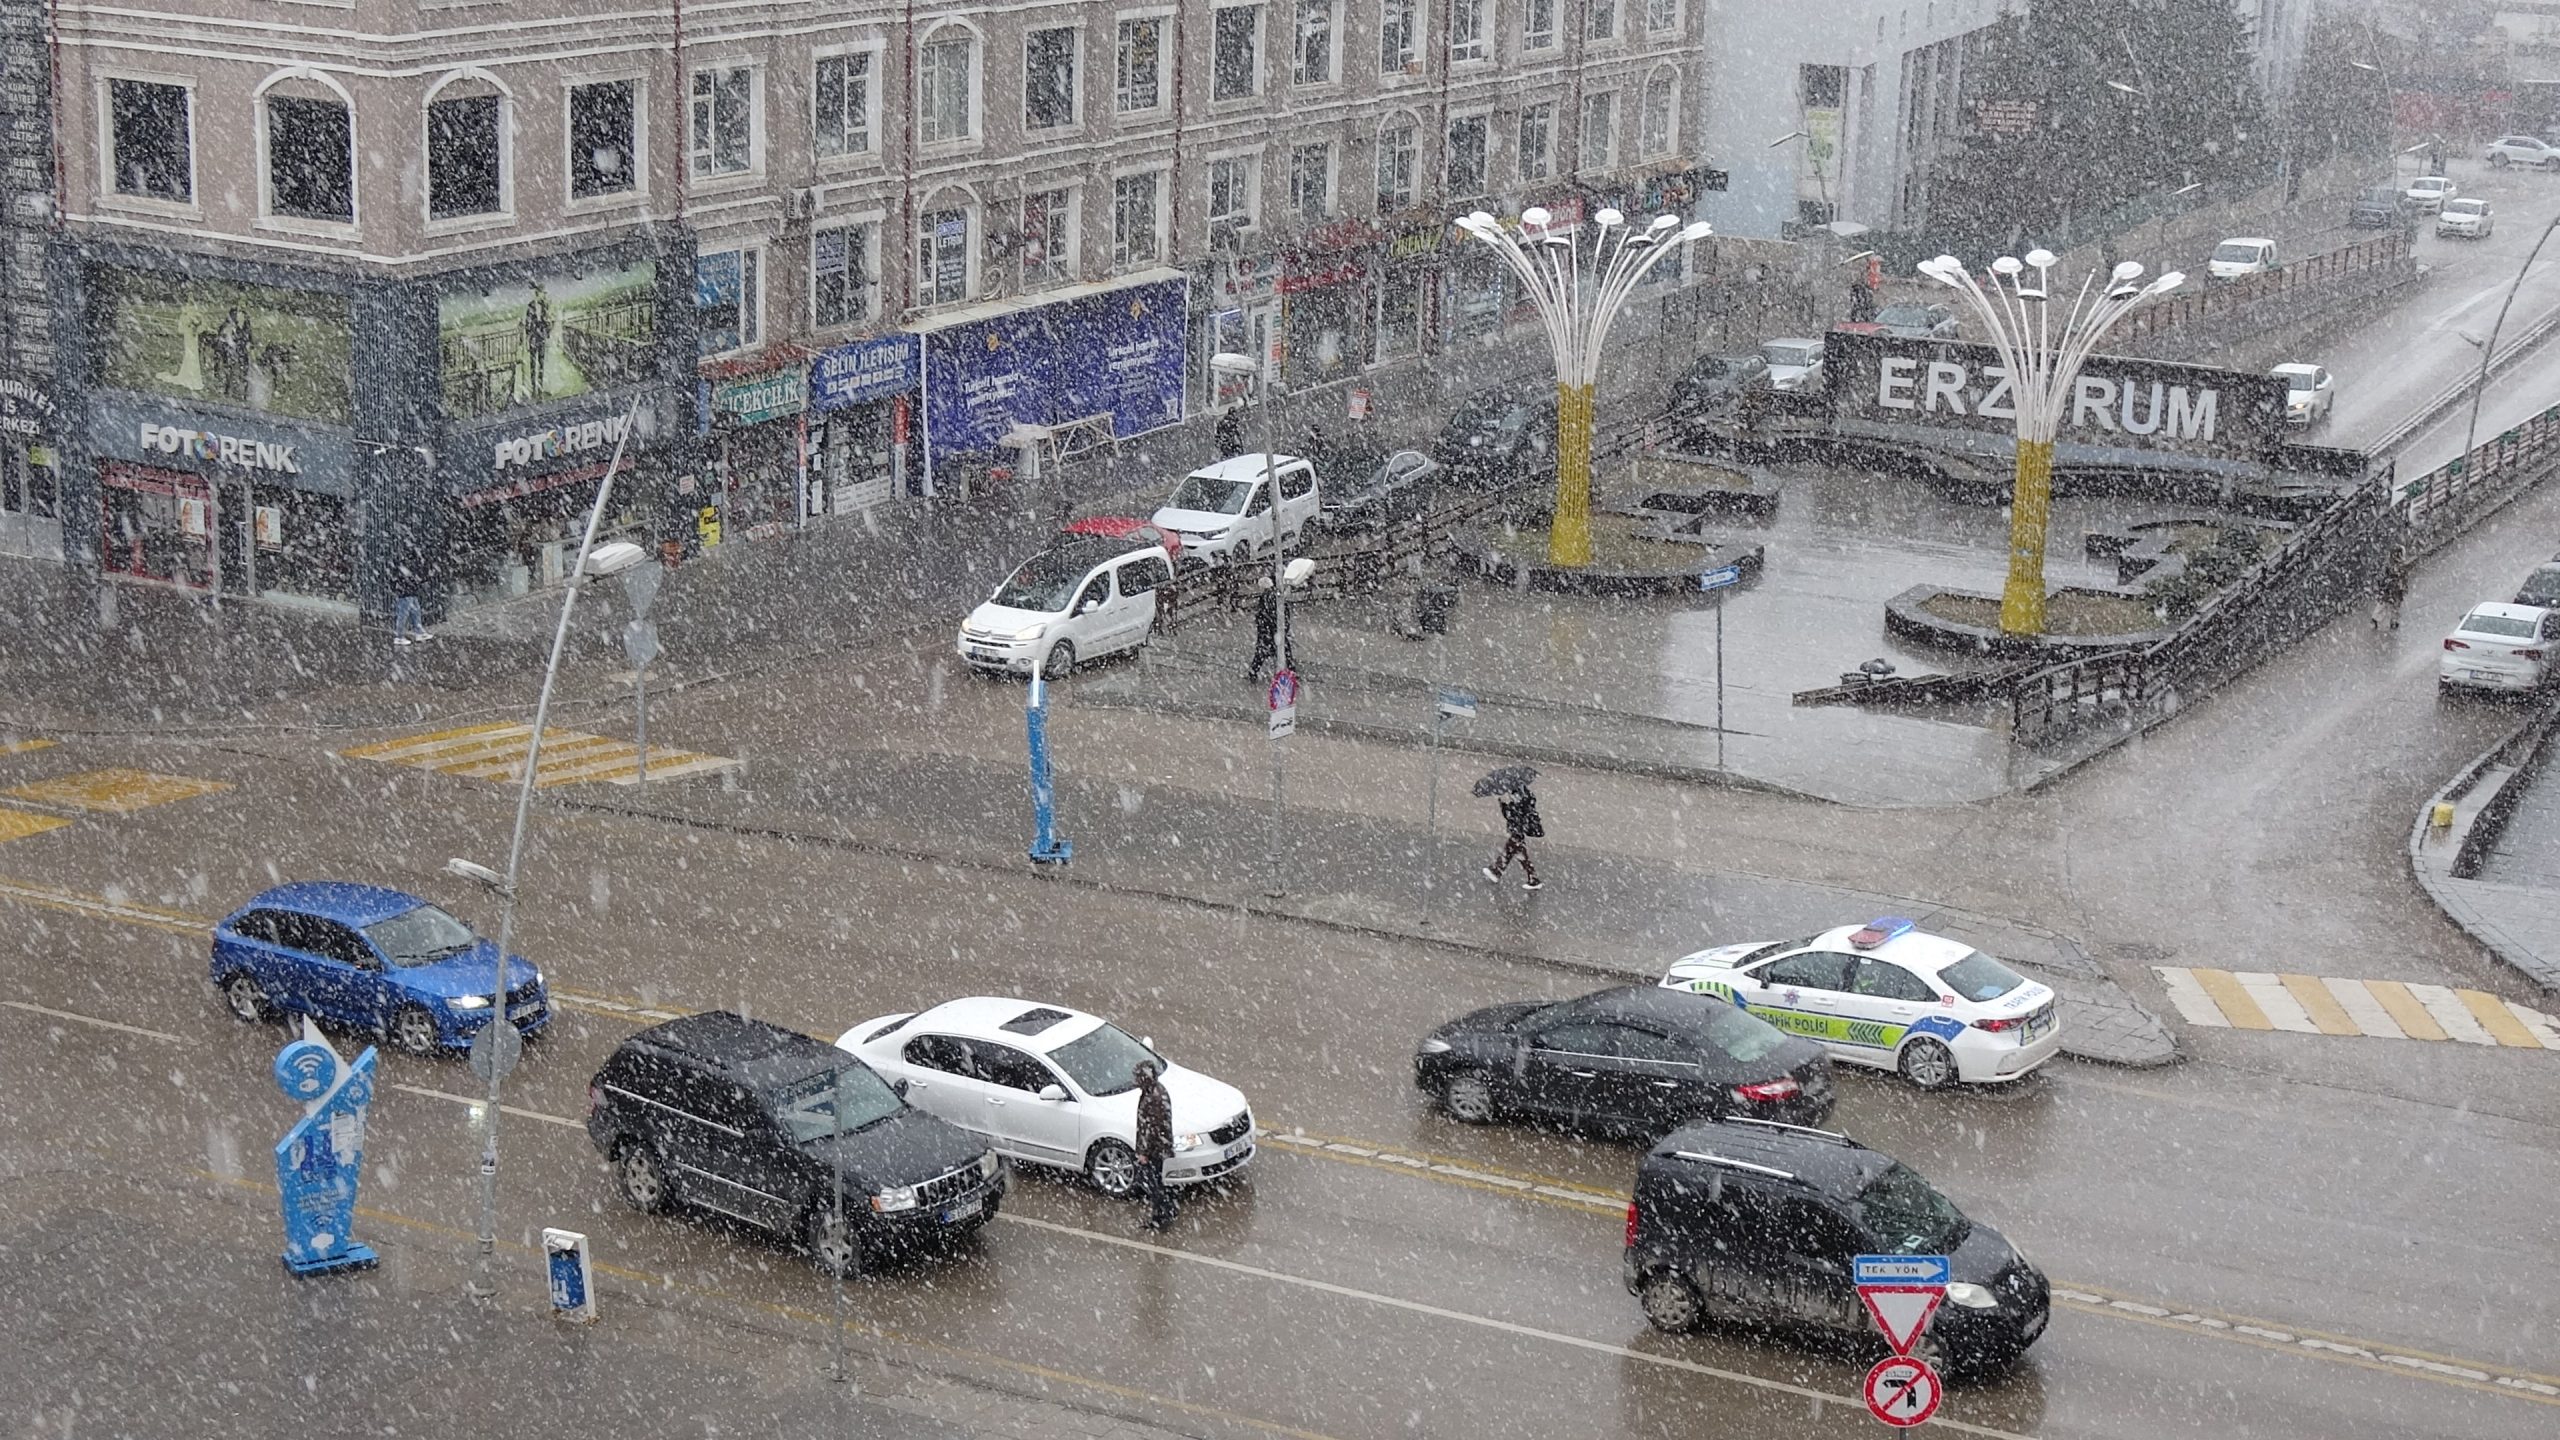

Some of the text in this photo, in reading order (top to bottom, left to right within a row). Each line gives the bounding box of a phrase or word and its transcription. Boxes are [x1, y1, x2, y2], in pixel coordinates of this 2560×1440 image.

[1878, 357, 2217, 441] ERZRUM
[141, 422, 297, 474] FOTORENK
[1864, 1265, 1919, 1274] TEK YÖN
